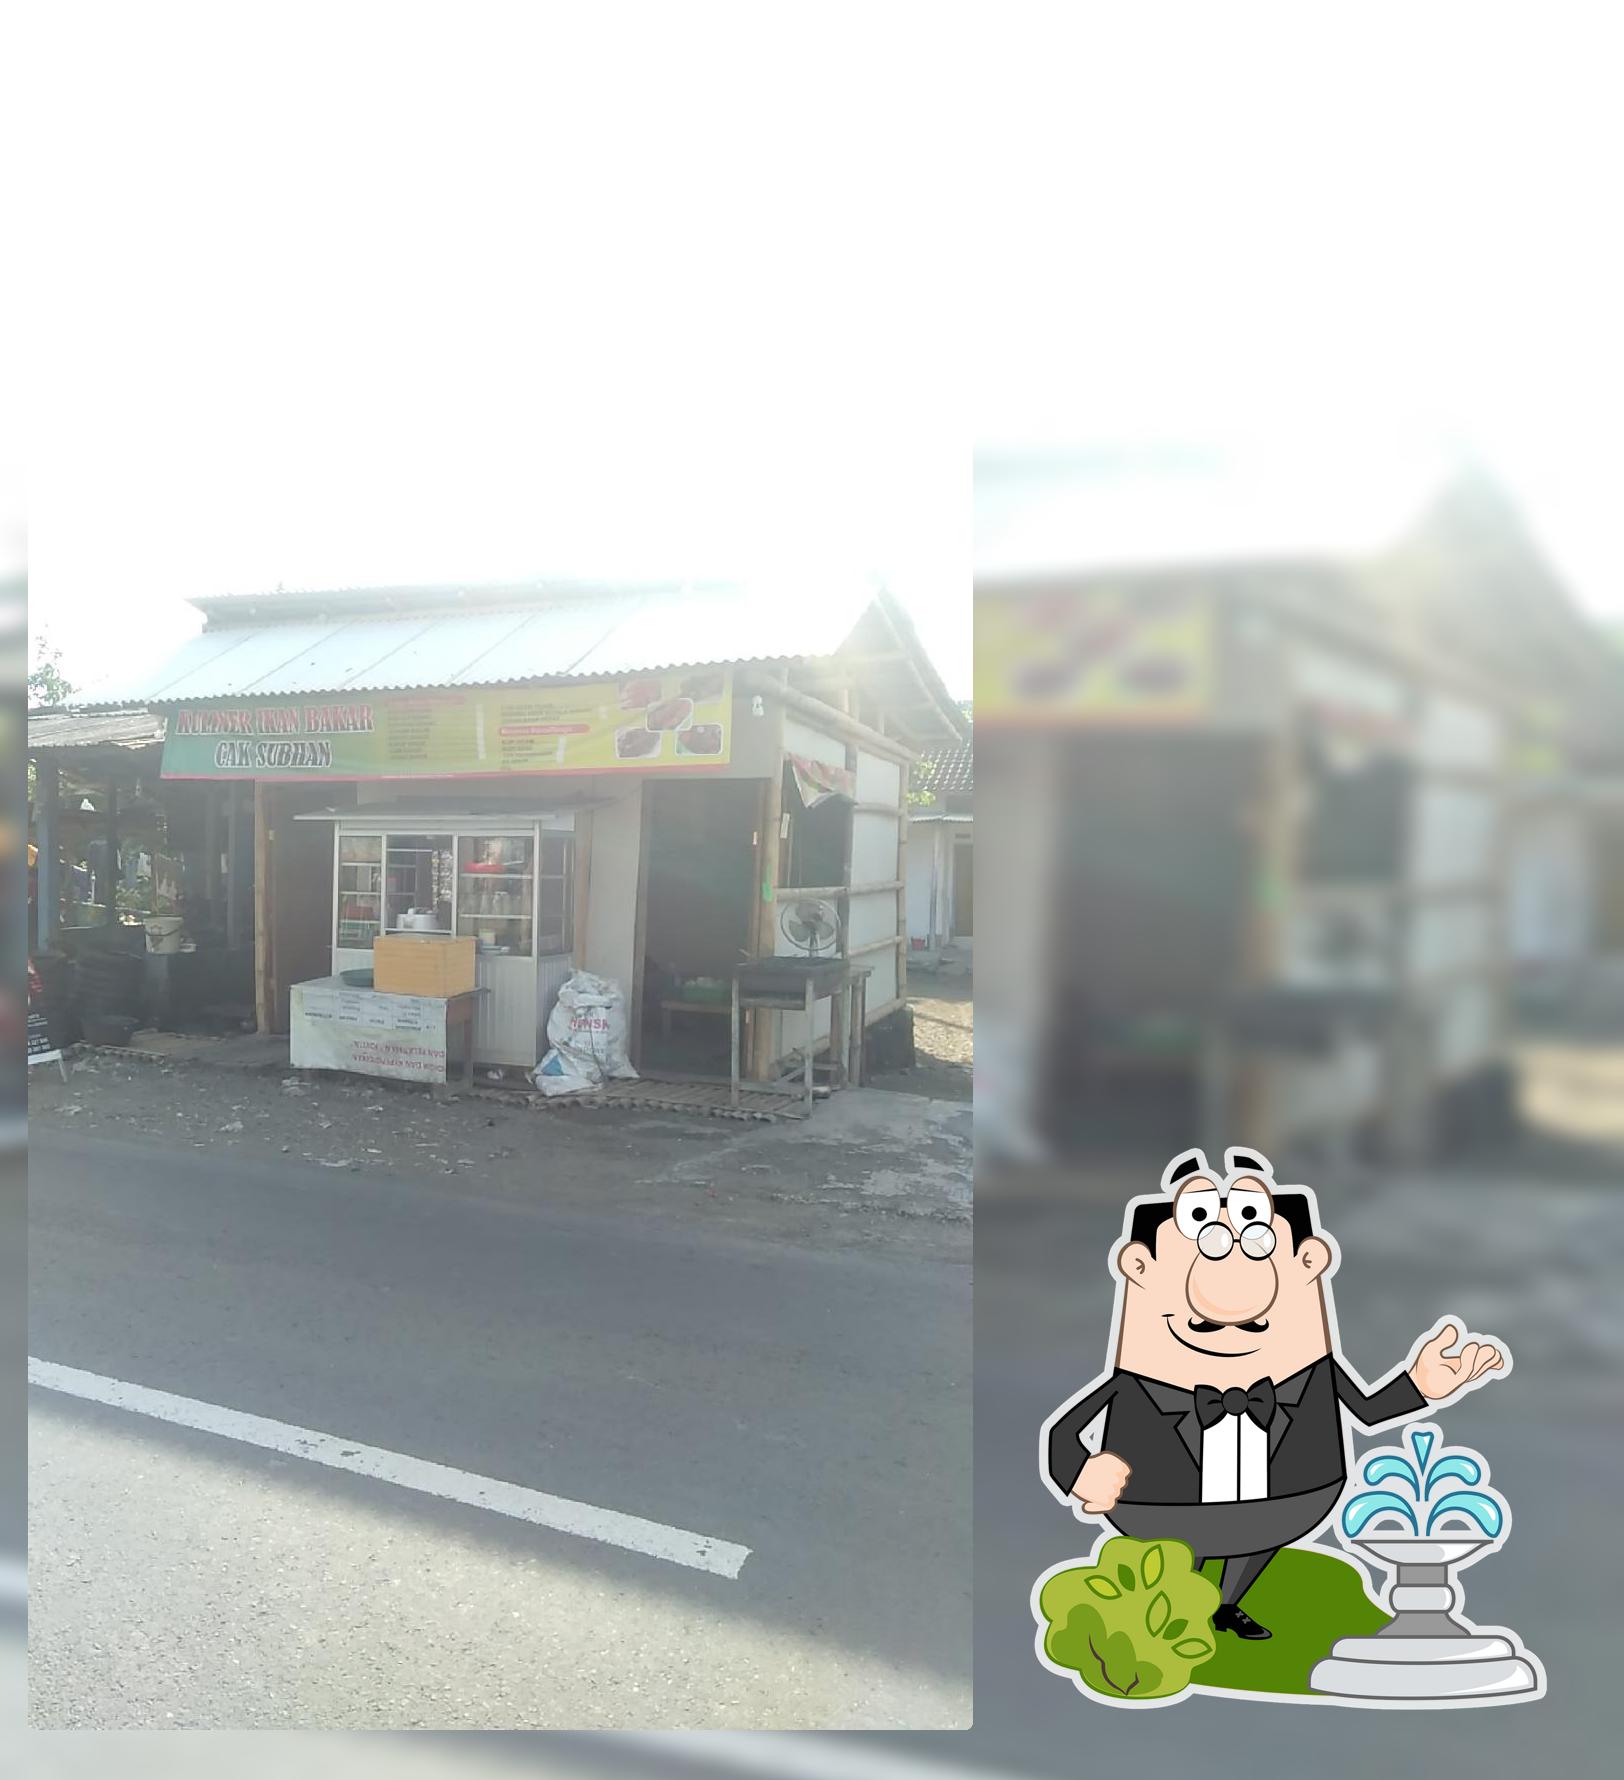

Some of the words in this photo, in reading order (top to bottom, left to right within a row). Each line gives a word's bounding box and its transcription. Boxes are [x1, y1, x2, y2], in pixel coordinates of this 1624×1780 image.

[256, 706, 301, 735] IKAN
[304, 704, 375, 733] BAKAR
[215, 740, 253, 768] CAK
[256, 740, 332, 768] SUBHAN
